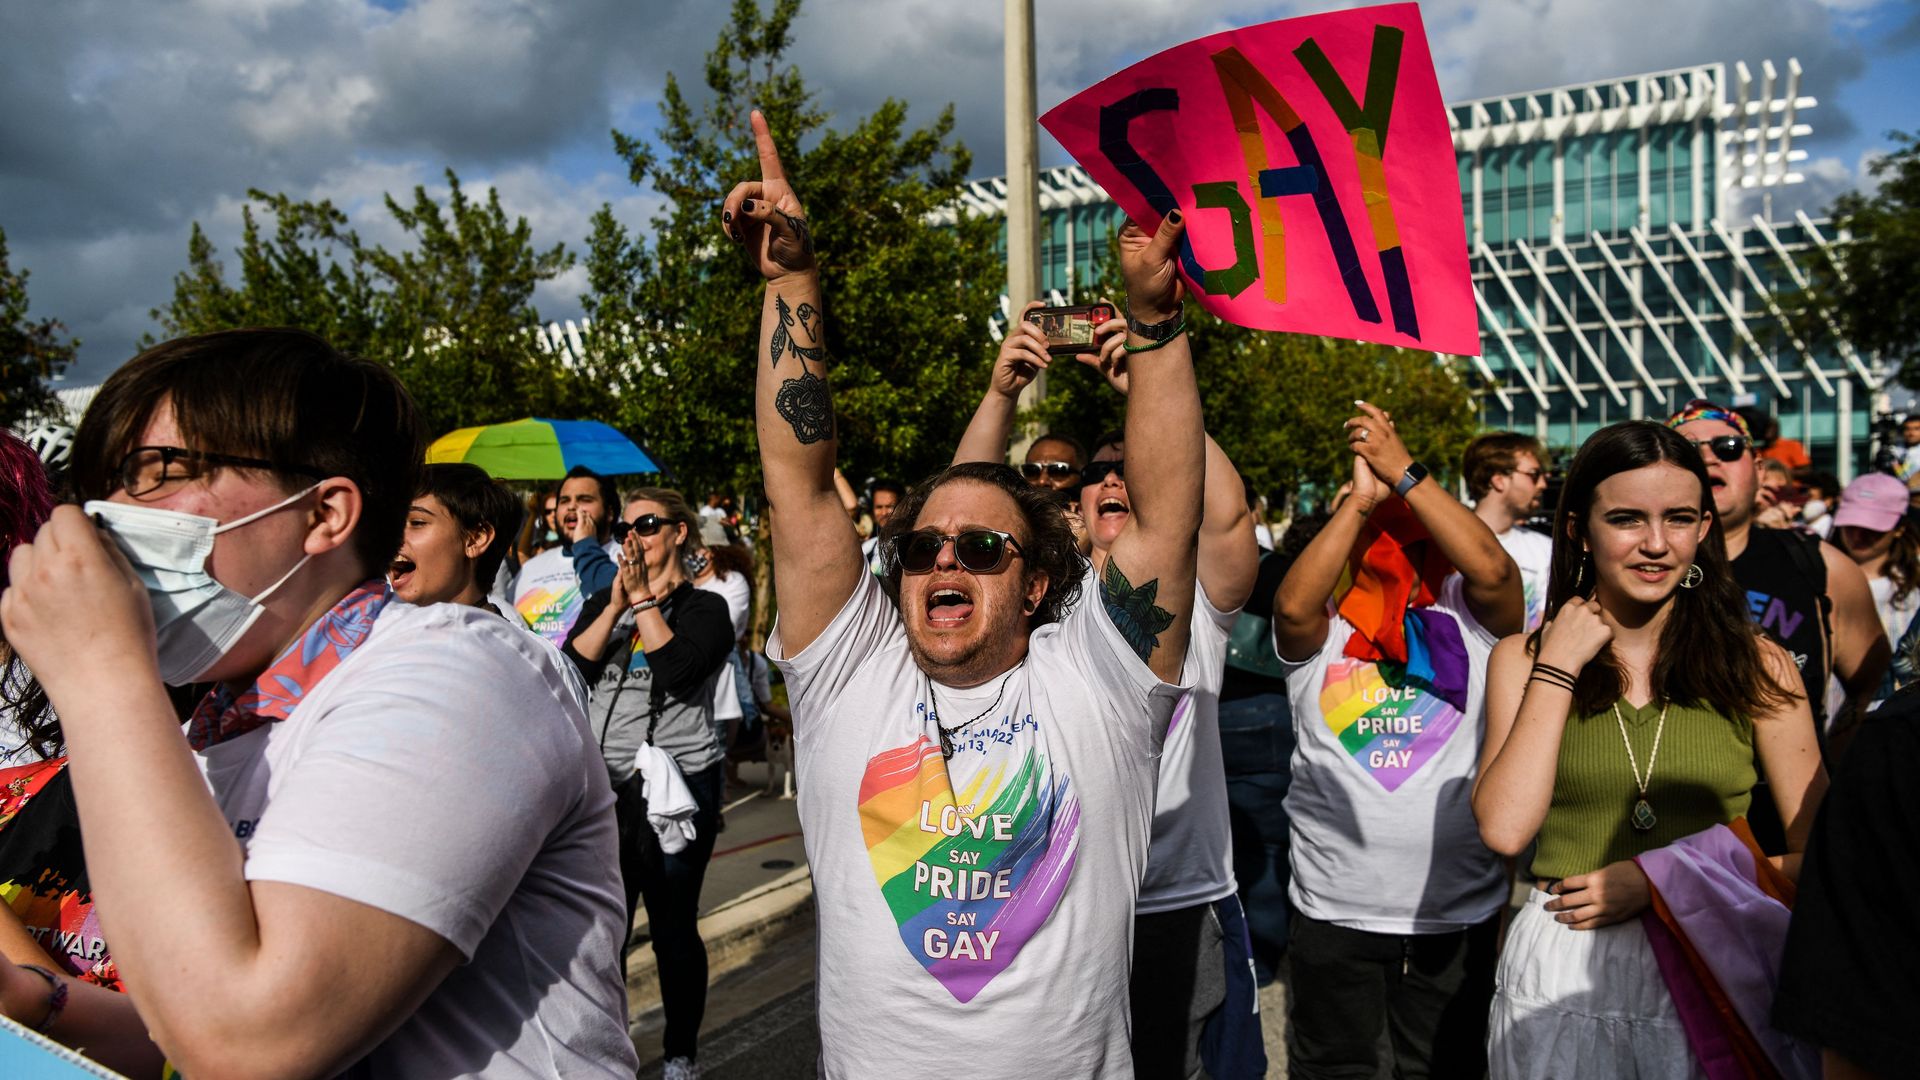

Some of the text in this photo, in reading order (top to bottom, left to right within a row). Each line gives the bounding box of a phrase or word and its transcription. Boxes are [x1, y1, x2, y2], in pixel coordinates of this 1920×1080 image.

[1099, 24, 1421, 343] GAY
[532, 602, 563, 614] LOVE
[532, 620, 565, 632] PRIDE
[1363, 685, 1416, 703] LOVE
[1381, 708, 1398, 716] SAY
[1357, 715, 1423, 735] PRIDE
[1383, 740, 1400, 748] SAY
[1369, 750, 1413, 768] GAY
[920, 800, 1013, 841] LOVE
[949, 850, 980, 865] SAY
[913, 860, 1012, 900] PRIDE
[947, 912, 976, 926] SAY
[923, 928, 1001, 961] GAY
